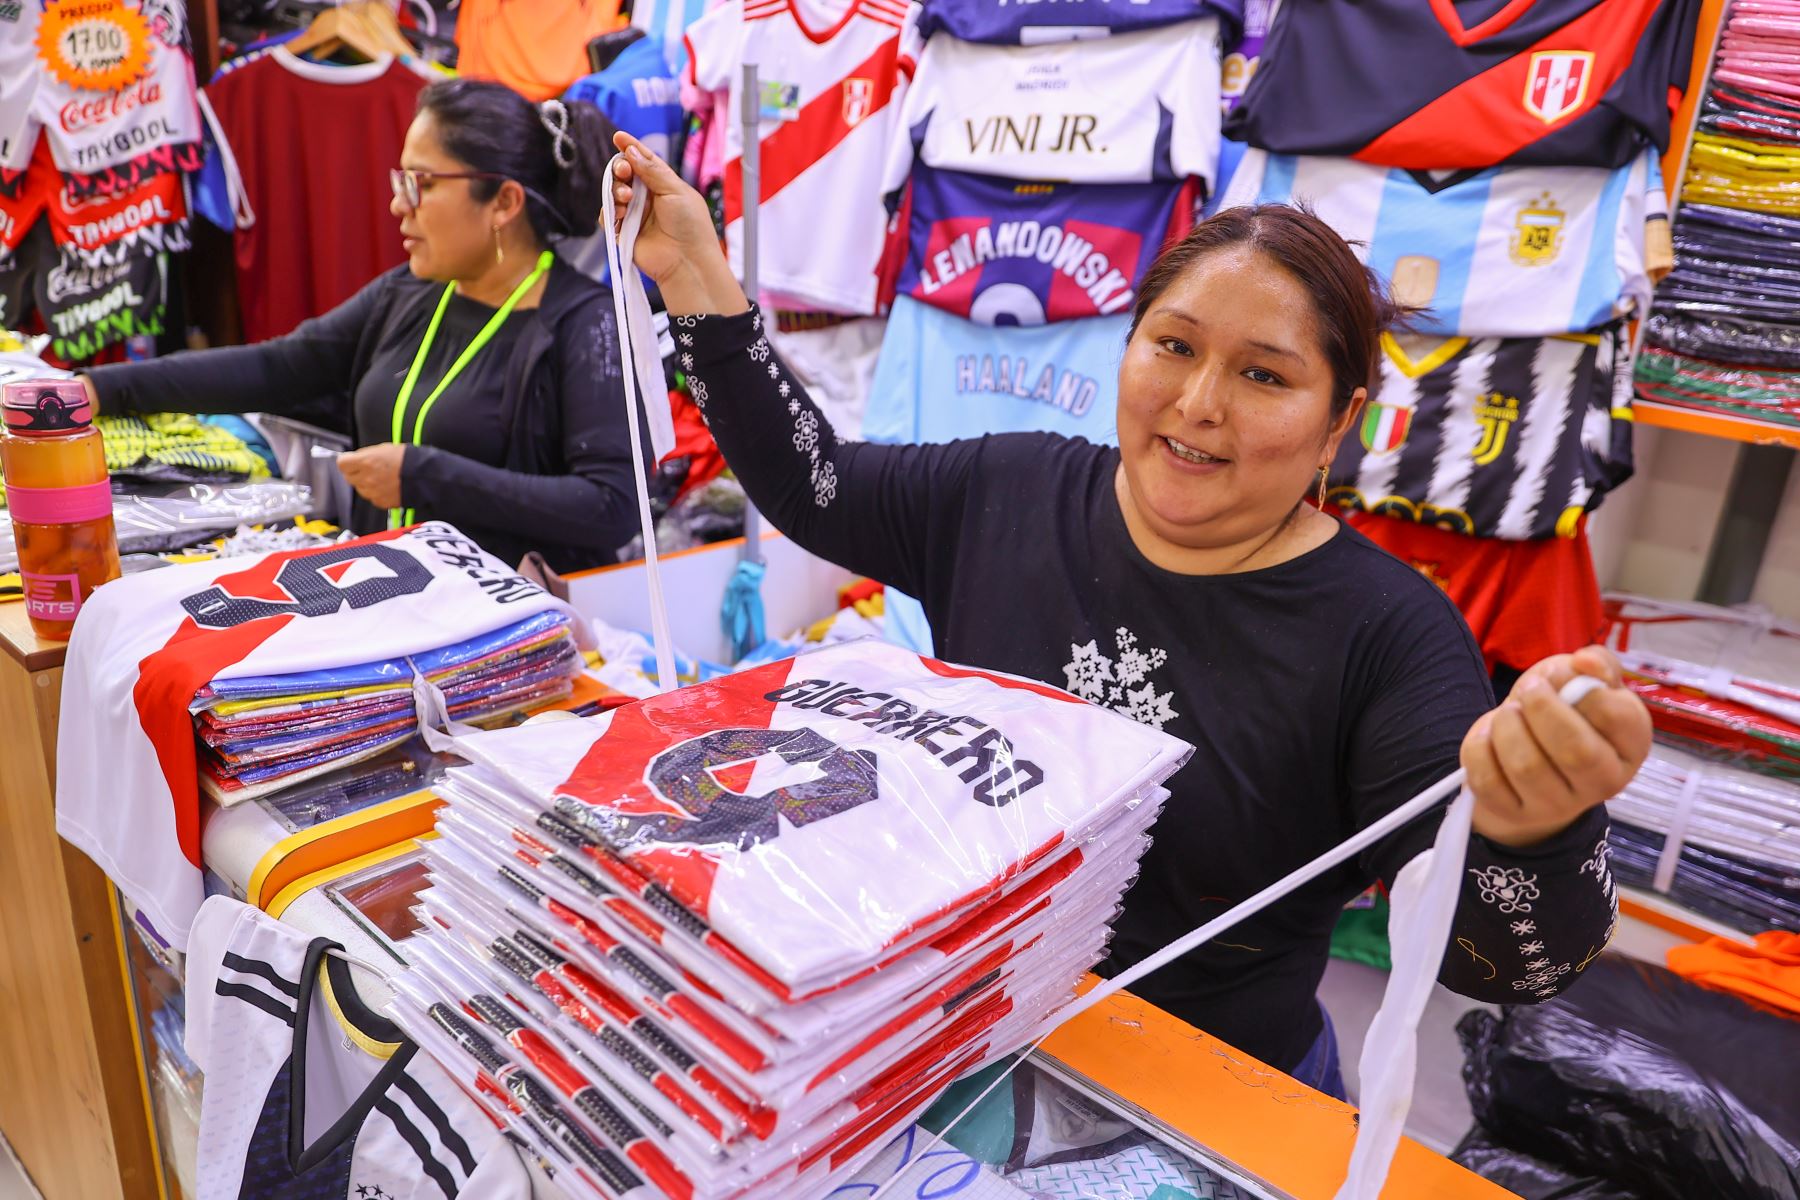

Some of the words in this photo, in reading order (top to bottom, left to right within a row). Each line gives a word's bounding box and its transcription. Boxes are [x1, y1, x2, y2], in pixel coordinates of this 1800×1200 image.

[965, 113, 1041, 154] VINI
[1049, 113, 1109, 154] JR.
[920, 220, 1137, 316] LEWANDOWSKI
[955, 353, 1099, 419] HAALAND
[763, 678, 1044, 807] GUERRERO
